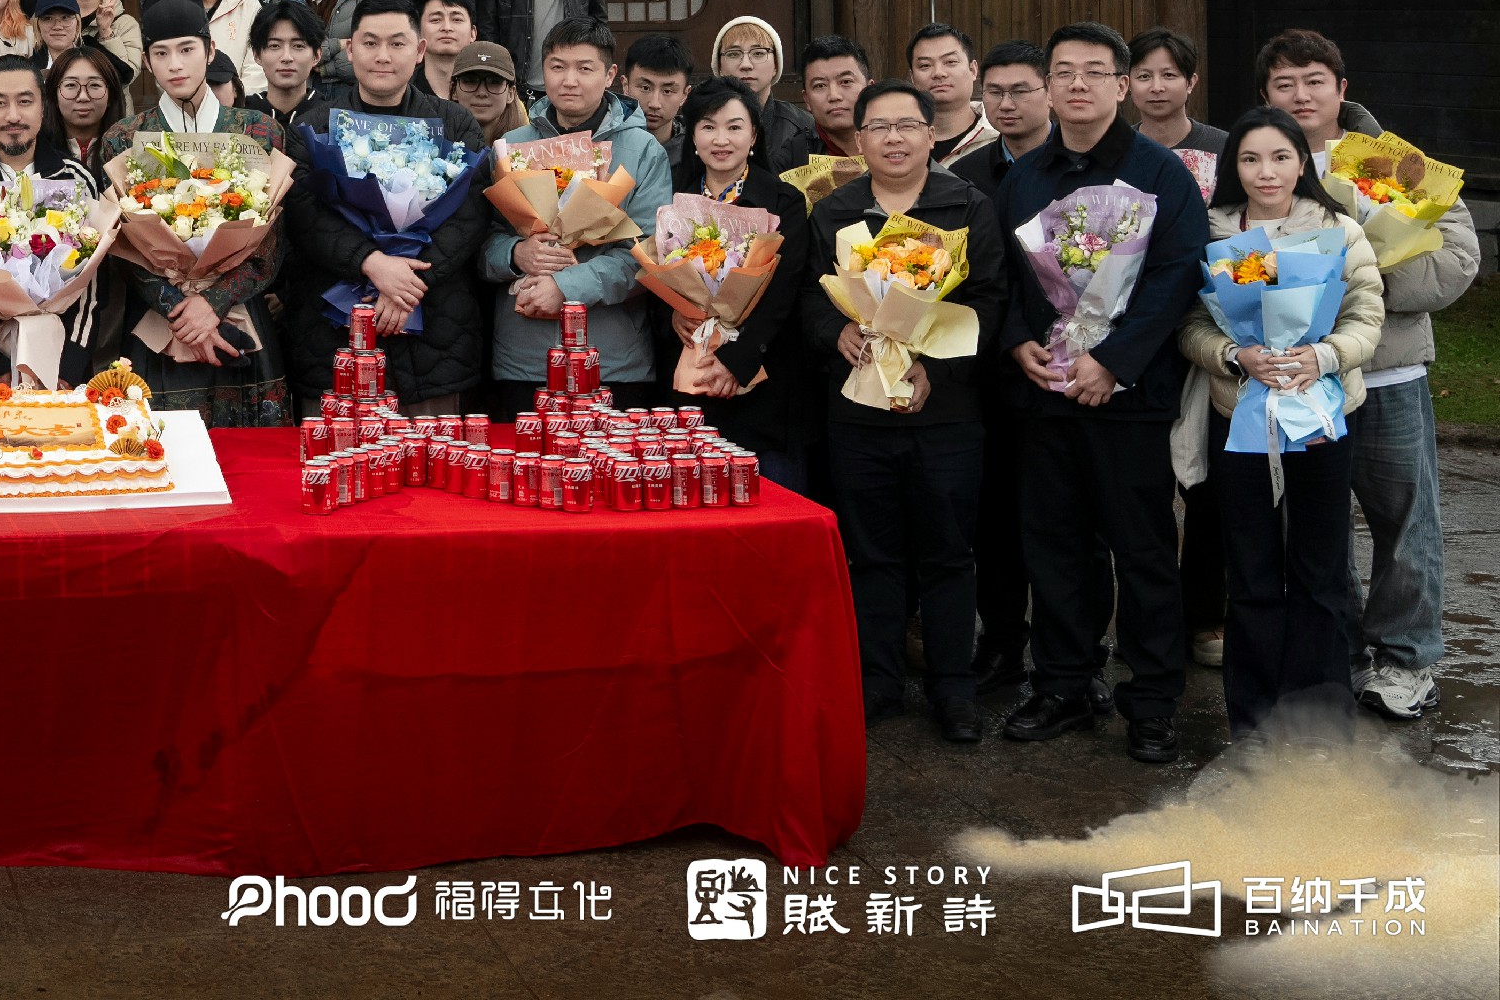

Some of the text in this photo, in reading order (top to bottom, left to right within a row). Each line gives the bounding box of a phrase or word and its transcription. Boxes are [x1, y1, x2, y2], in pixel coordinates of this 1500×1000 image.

[192, 142, 210, 152] MY
[213, 143, 263, 156] FAORITE
[1361, 137, 1387, 152] WITH
